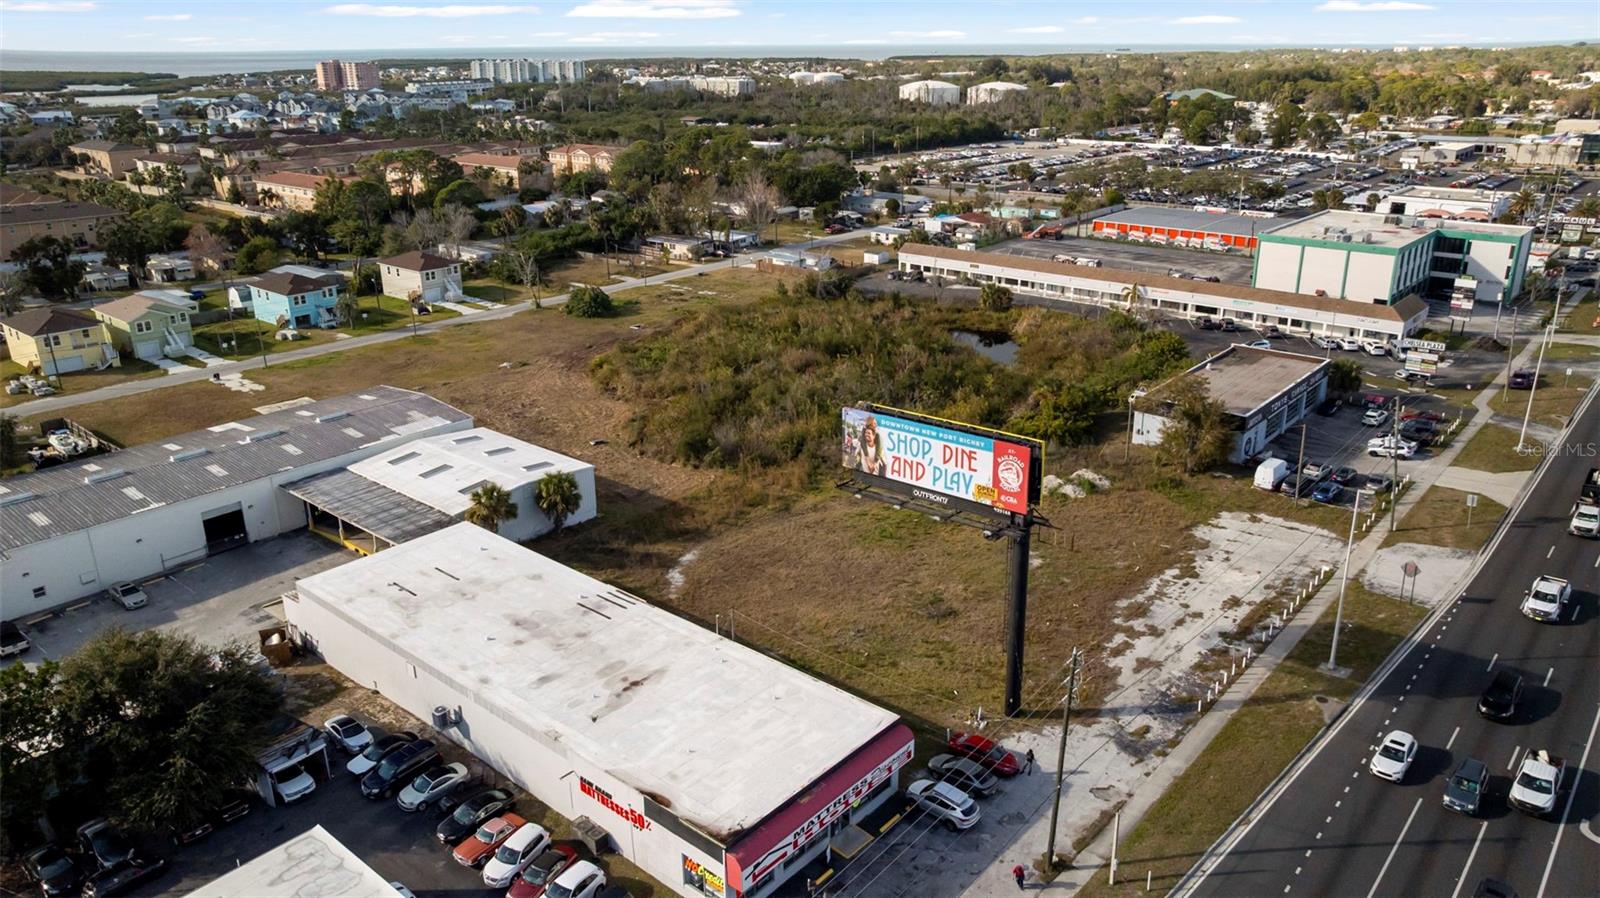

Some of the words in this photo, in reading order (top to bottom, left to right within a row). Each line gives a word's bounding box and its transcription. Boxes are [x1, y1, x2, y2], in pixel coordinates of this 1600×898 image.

[1426, 342, 1444, 350] PLAZA
[881, 419, 919, 433] DOWNTOWN
[921, 428, 937, 438] NEW
[939, 432, 957, 442] PORT
[959, 436, 985, 447] RICHEY
[887, 432, 933, 466] SHOP,
[943, 444, 977, 472] DINE
[891, 455, 925, 481] AND
[932, 465, 973, 495] PLAY
[997, 454, 1025, 469] RAILROAD
[580, 782, 630, 822] MATTRESSES
[793, 779, 868, 839] MATTRESS
